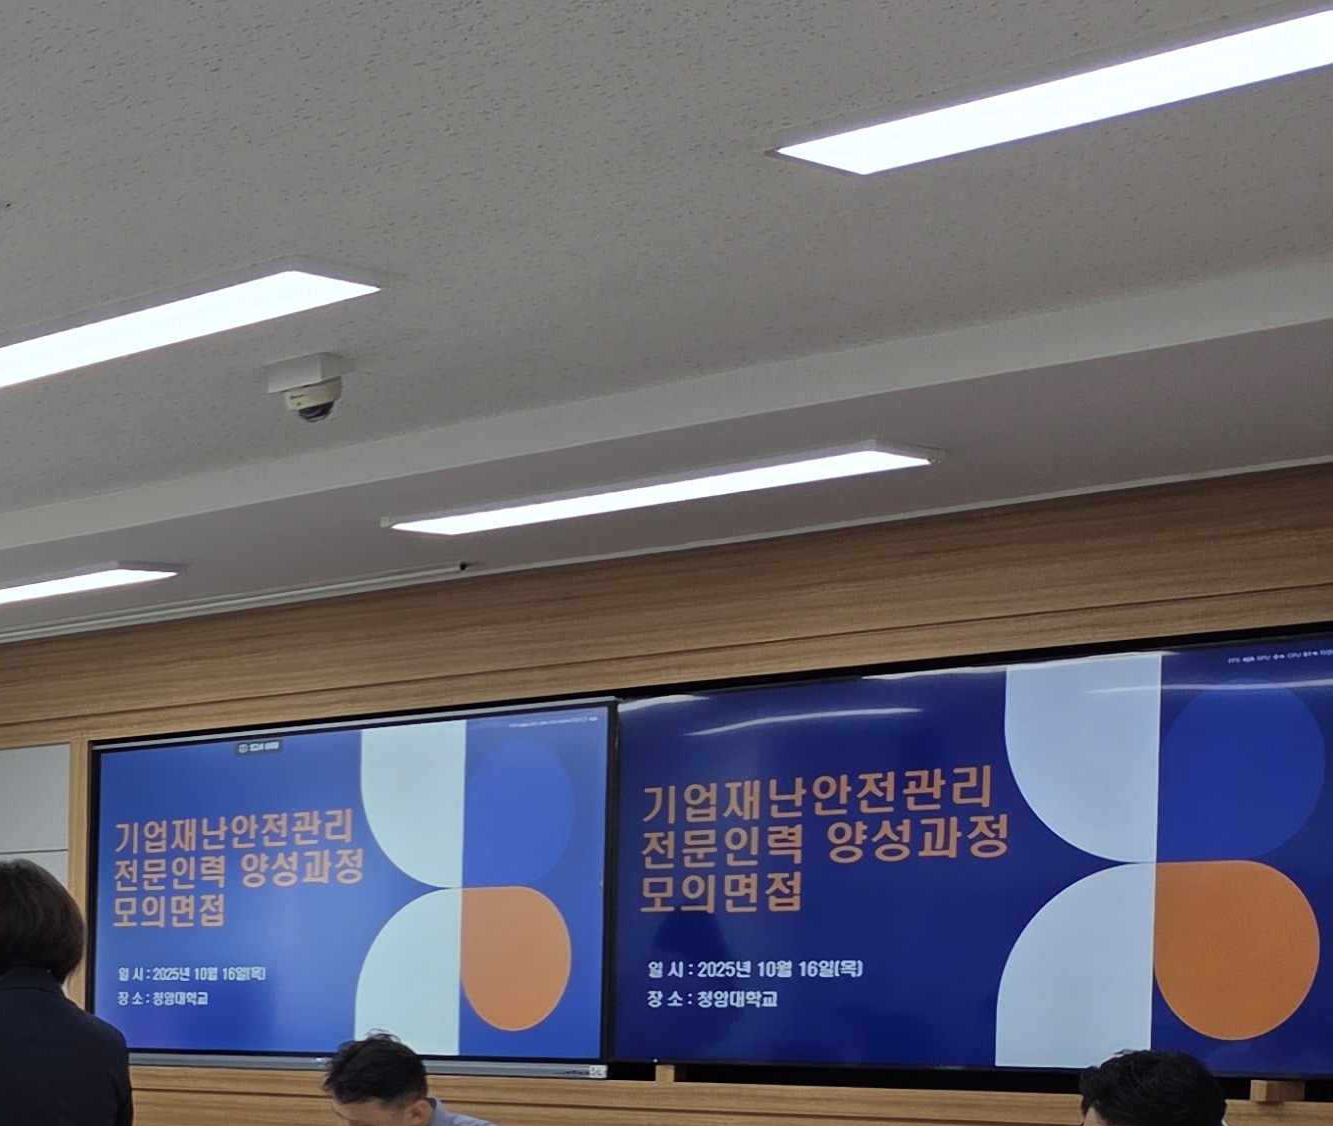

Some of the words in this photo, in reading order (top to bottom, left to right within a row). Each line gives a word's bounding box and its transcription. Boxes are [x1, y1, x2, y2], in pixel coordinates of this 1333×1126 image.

[642, 765, 992, 824] 기업재난안전관리
[114, 808, 353, 854] 기업재난안전관리
[641, 824, 803, 870] 전문인력
[827, 814, 1008, 864] 양성과정
[114, 855, 225, 892] 전문인력
[240, 848, 364, 888] 양성과정
[112, 894, 224, 928] 모의면접
[640, 871, 802, 914] 모의면접
[152, 967, 190, 982] 2025년
[194, 967, 218, 981] 10월
[697, 960, 751, 978] 2025년
[757, 960, 792, 978] 10월
[799, 960, 863, 978] 16일(목)
[697, 990, 778, 1008] 청암대학교
